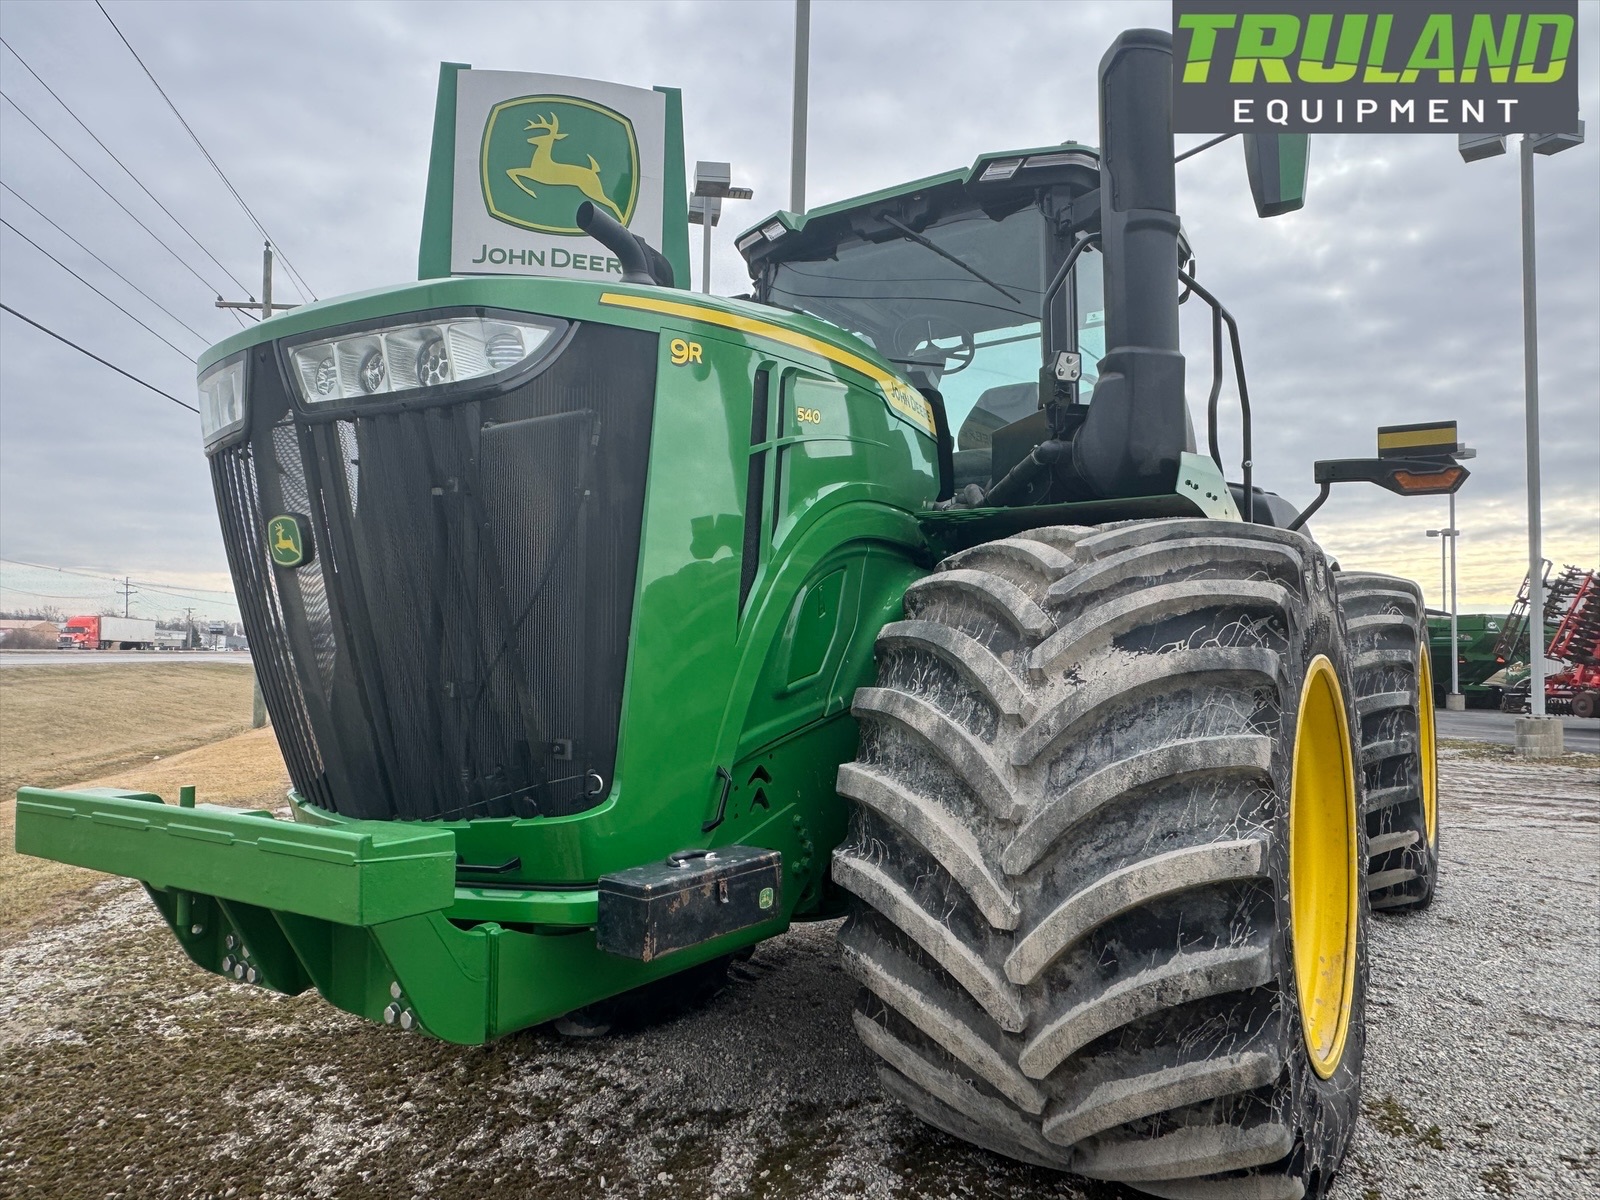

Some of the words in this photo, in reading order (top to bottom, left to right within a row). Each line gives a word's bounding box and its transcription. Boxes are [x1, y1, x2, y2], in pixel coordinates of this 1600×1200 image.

[472, 244, 546, 267] JOHN
[551, 247, 623, 275] DEER
[670, 338, 703, 365] 9R
[797, 406, 821, 425] 540
[890, 381, 911, 409] JOHN
[909, 394, 932, 424] DEERE
